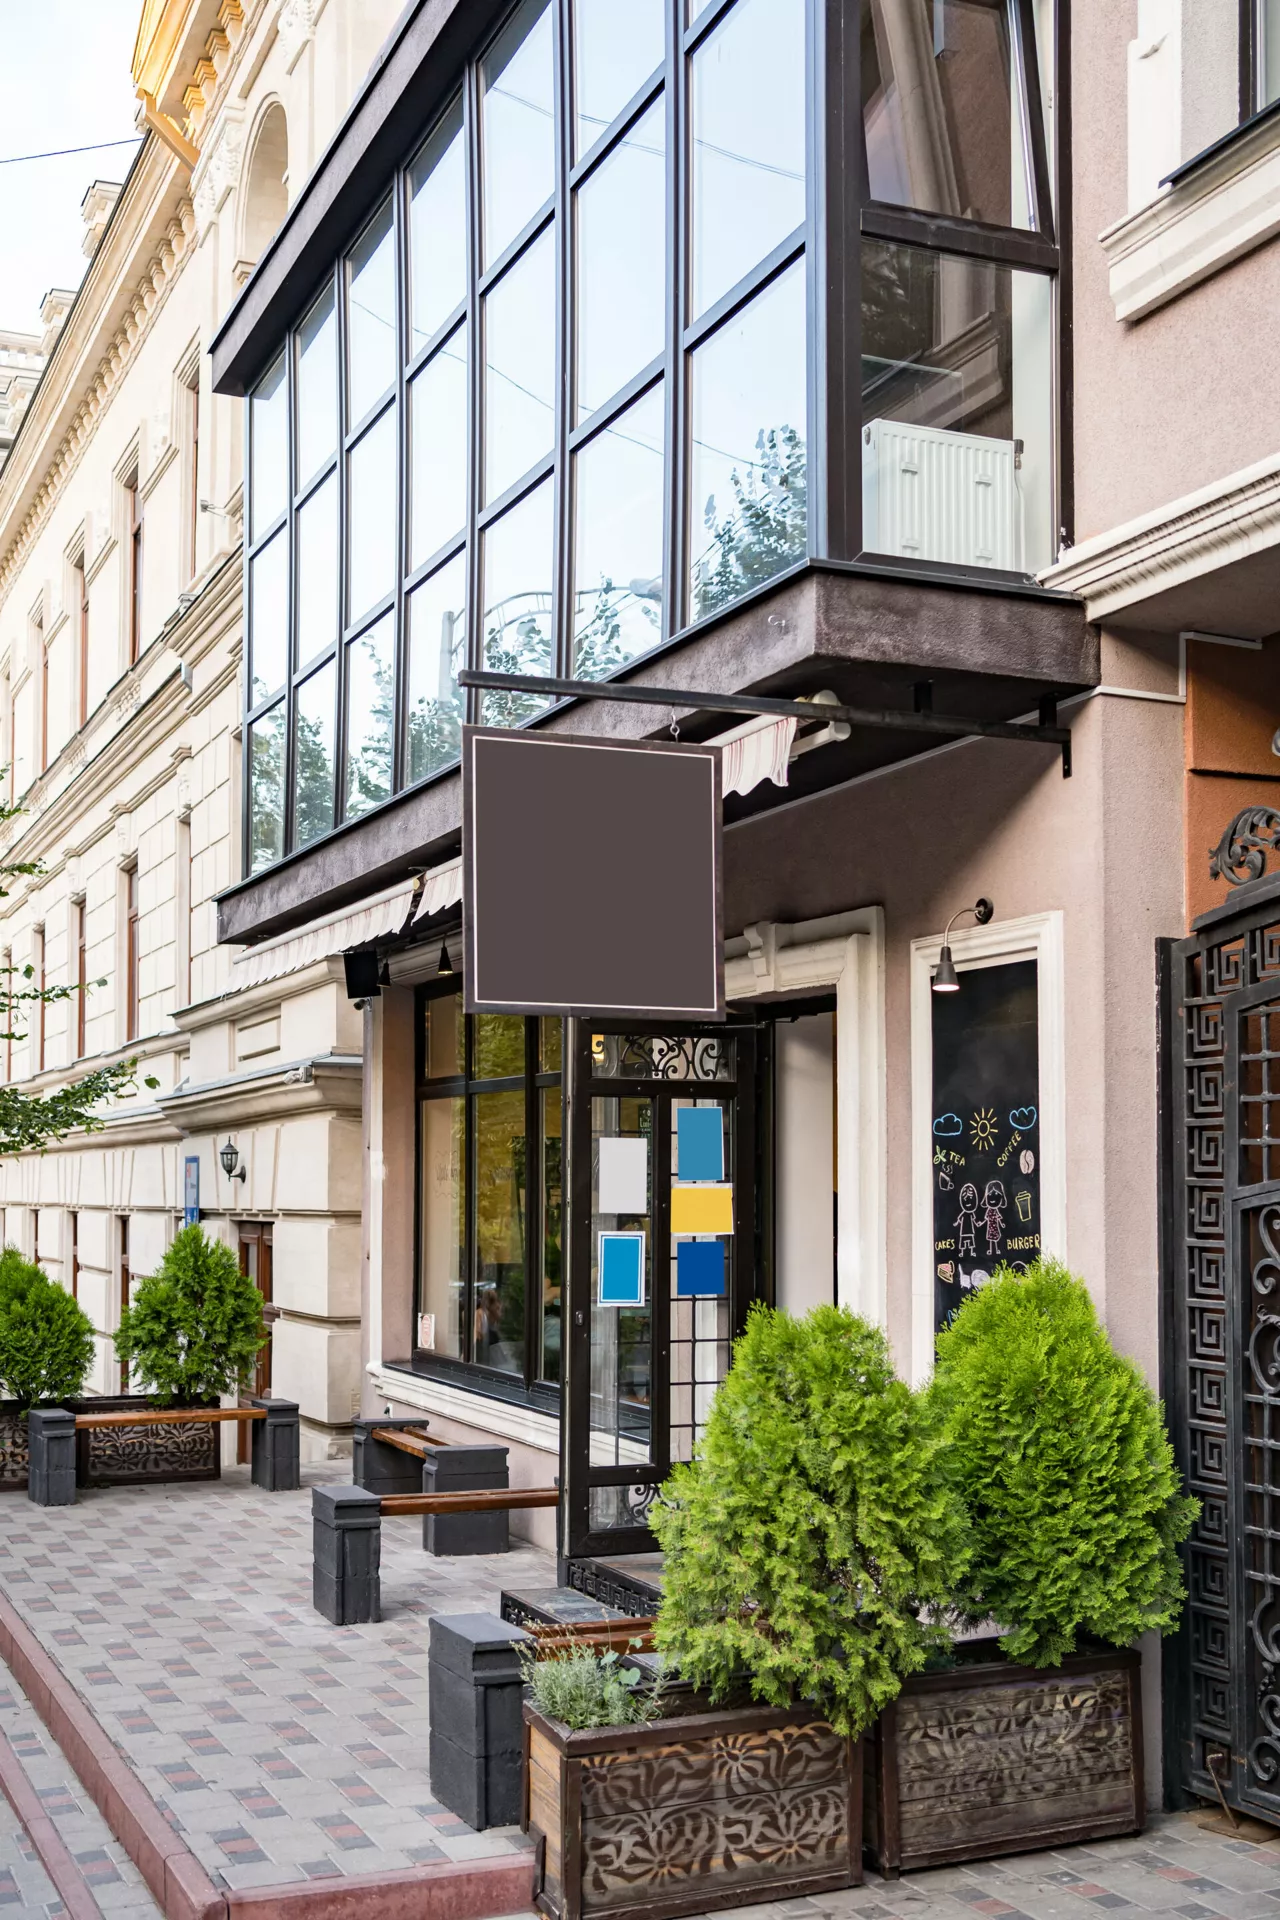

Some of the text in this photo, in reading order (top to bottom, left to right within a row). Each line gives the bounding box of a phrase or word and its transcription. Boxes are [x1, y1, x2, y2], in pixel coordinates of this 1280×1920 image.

[996, 1130, 1022, 1167] COFFEE
[949, 1151, 966, 1166] TEA
[935, 1238, 955, 1251] CAKES
[1006, 1233, 1040, 1250] BURGER
